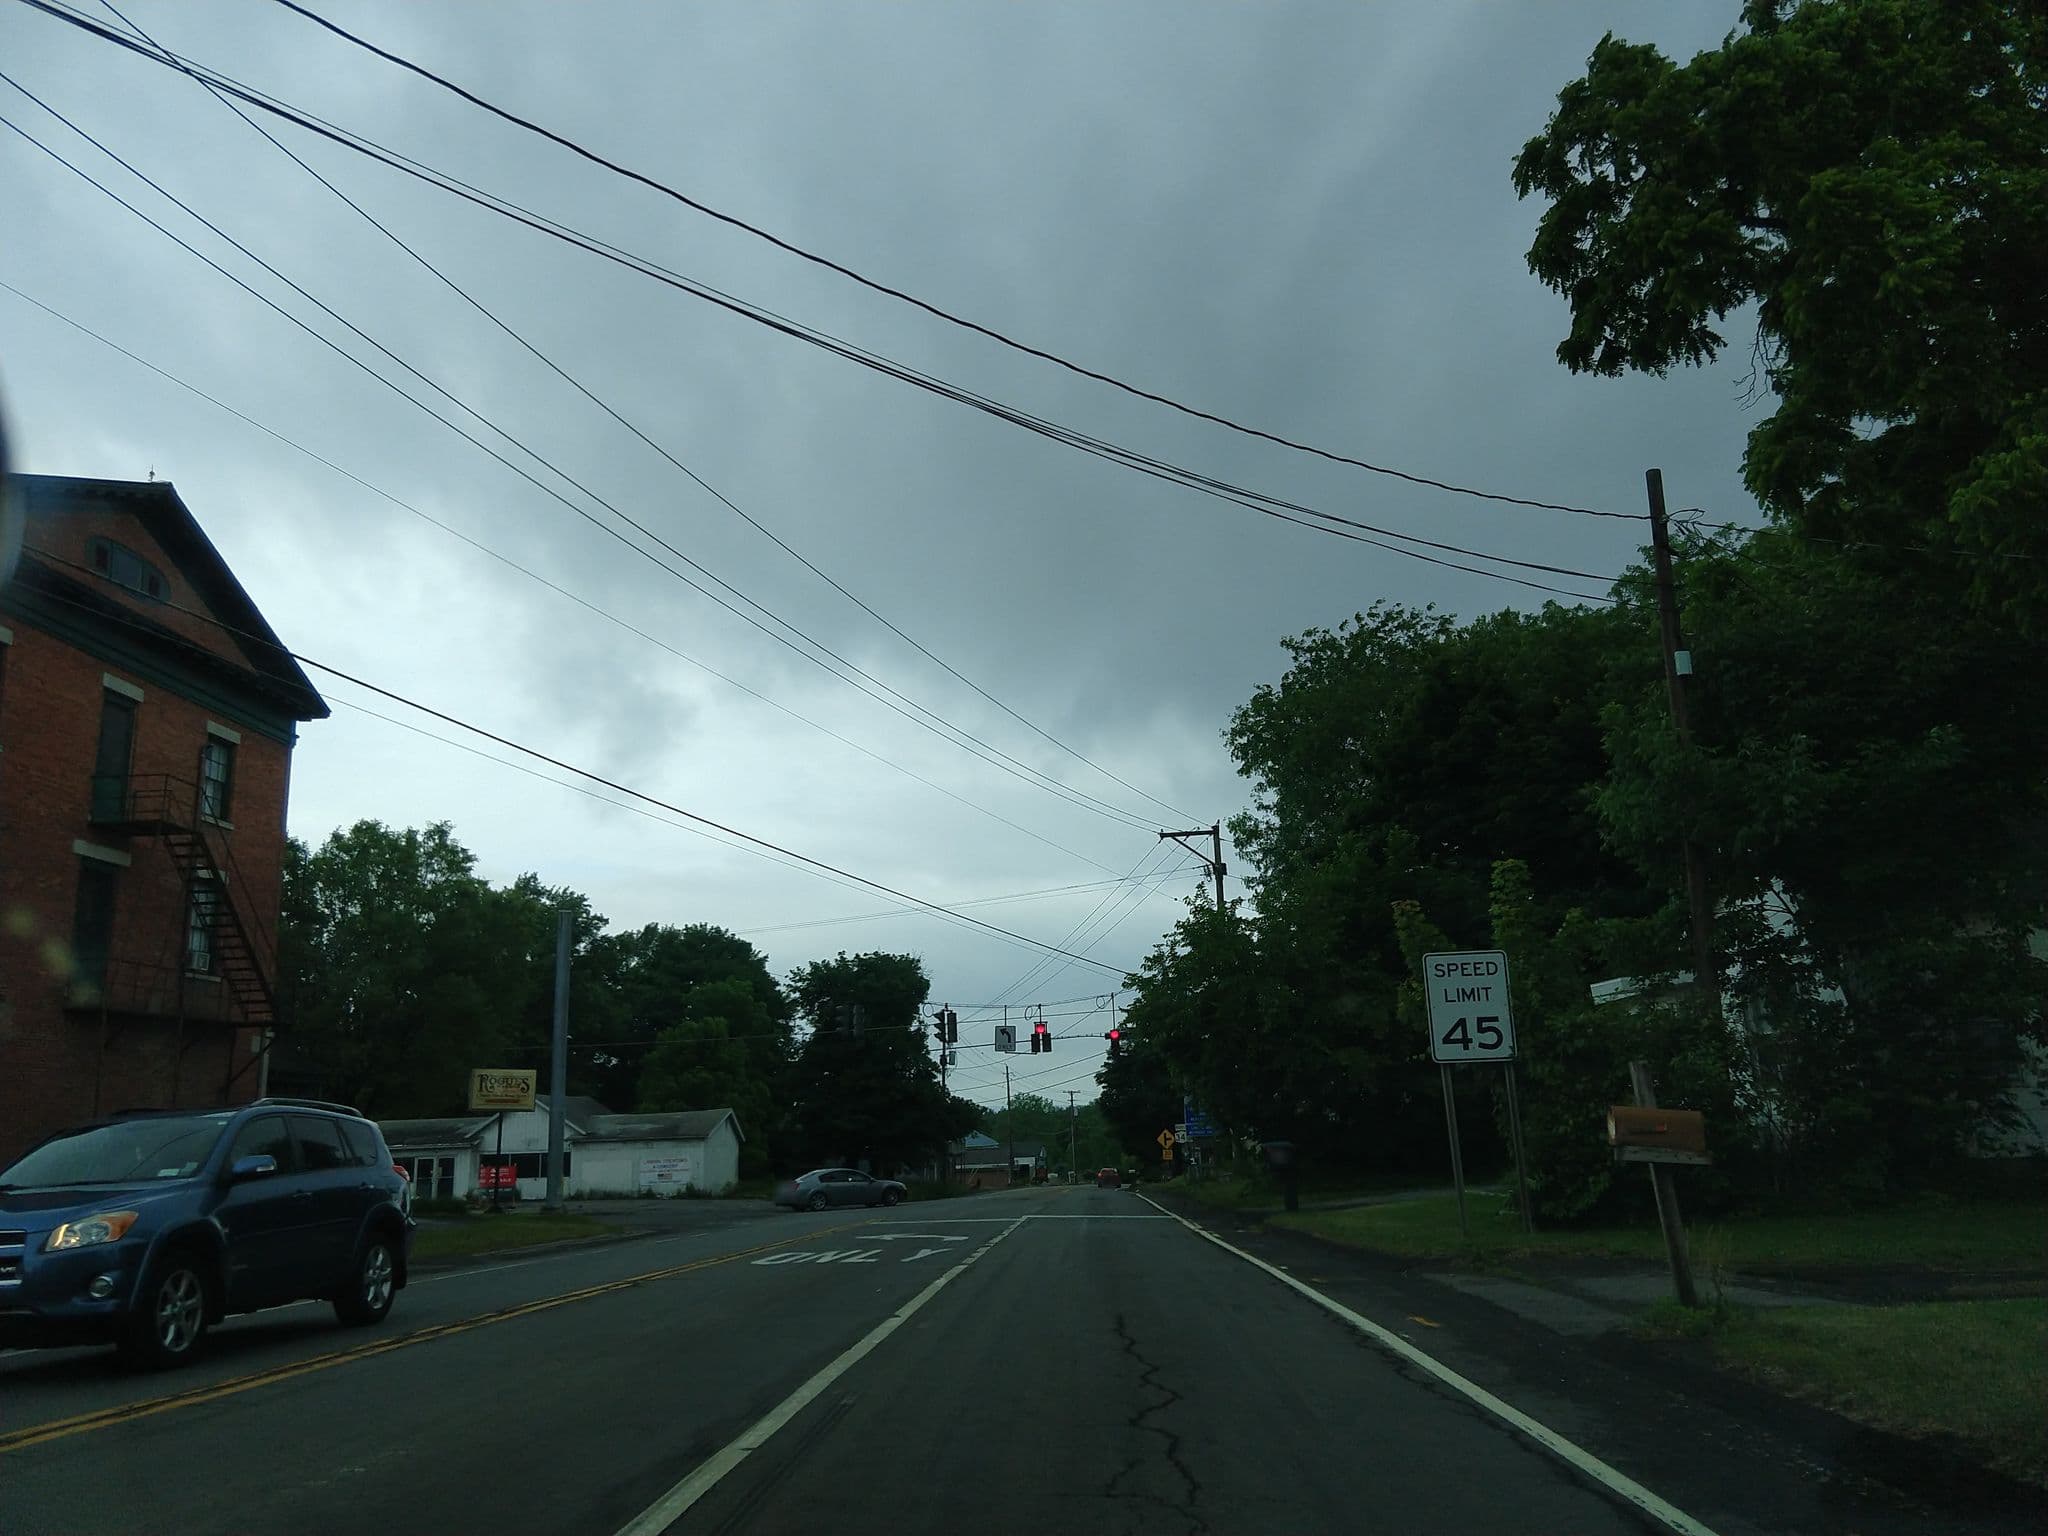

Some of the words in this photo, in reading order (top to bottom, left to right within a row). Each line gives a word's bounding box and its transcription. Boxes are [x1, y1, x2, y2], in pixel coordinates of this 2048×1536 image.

[1434, 961, 1498, 978] SPEED
[1444, 986, 1492, 1003] LIMIT
[1442, 1016, 1504, 1051] 45
